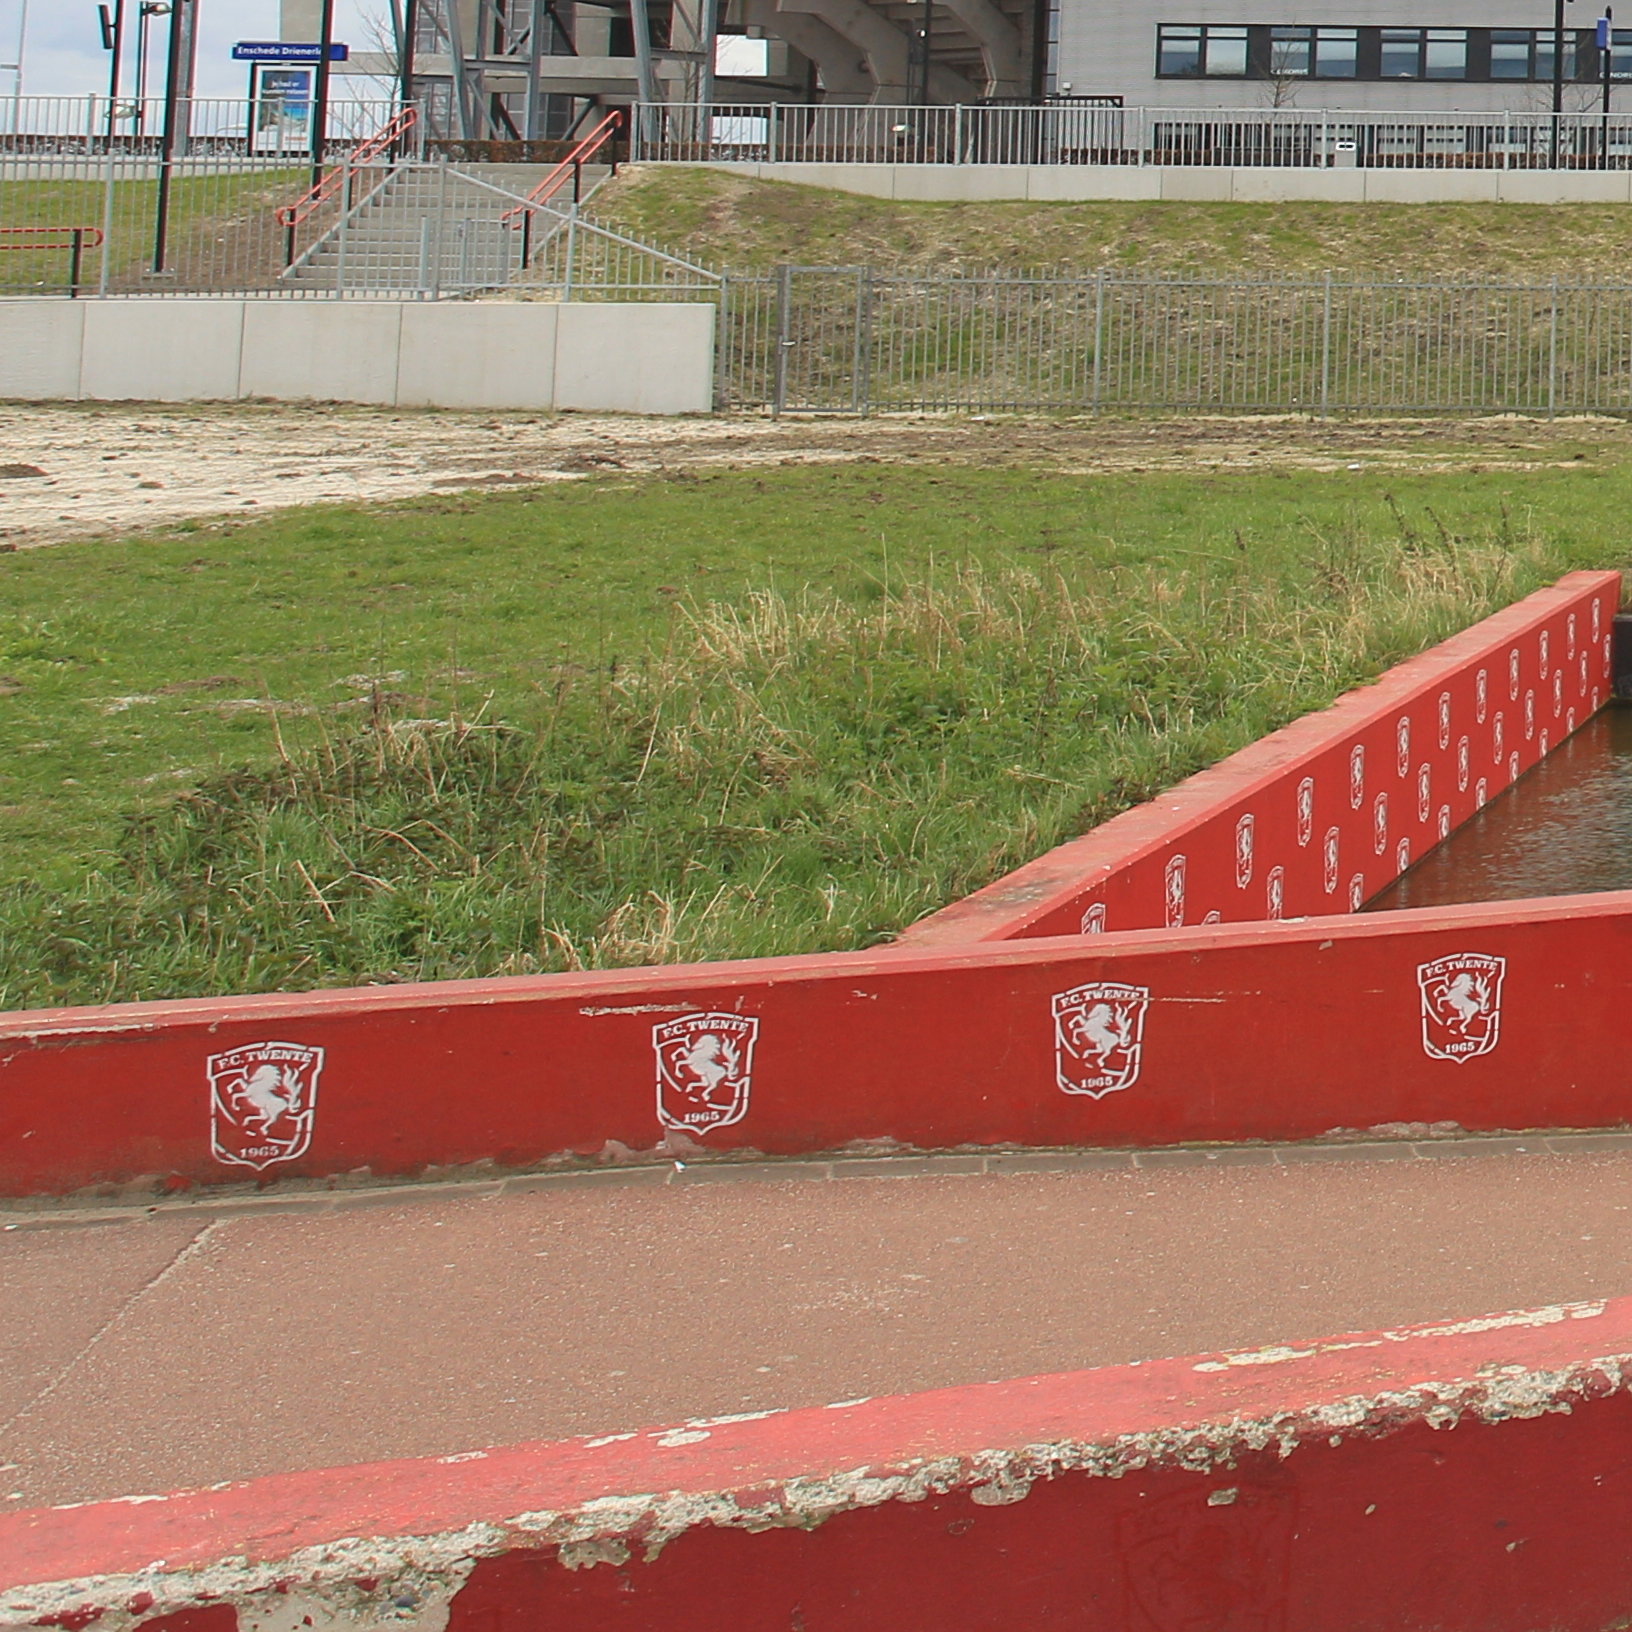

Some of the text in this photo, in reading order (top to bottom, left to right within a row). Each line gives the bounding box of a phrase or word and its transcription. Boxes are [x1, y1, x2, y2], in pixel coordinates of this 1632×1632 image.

[238, 46, 280, 56] Enschede
[1447, 959, 1498, 971] TWENTE
[1083, 989, 1140, 1001] TWENTE
[687, 1019, 749, 1033] TWENTE
[1445, 1042, 1476, 1054] 1965
[244, 1049, 314, 1063] TWENTE
[1080, 1077, 1113, 1089] 1965
[684, 1111, 720, 1123] 1965
[240, 1147, 279, 1158] 1965
